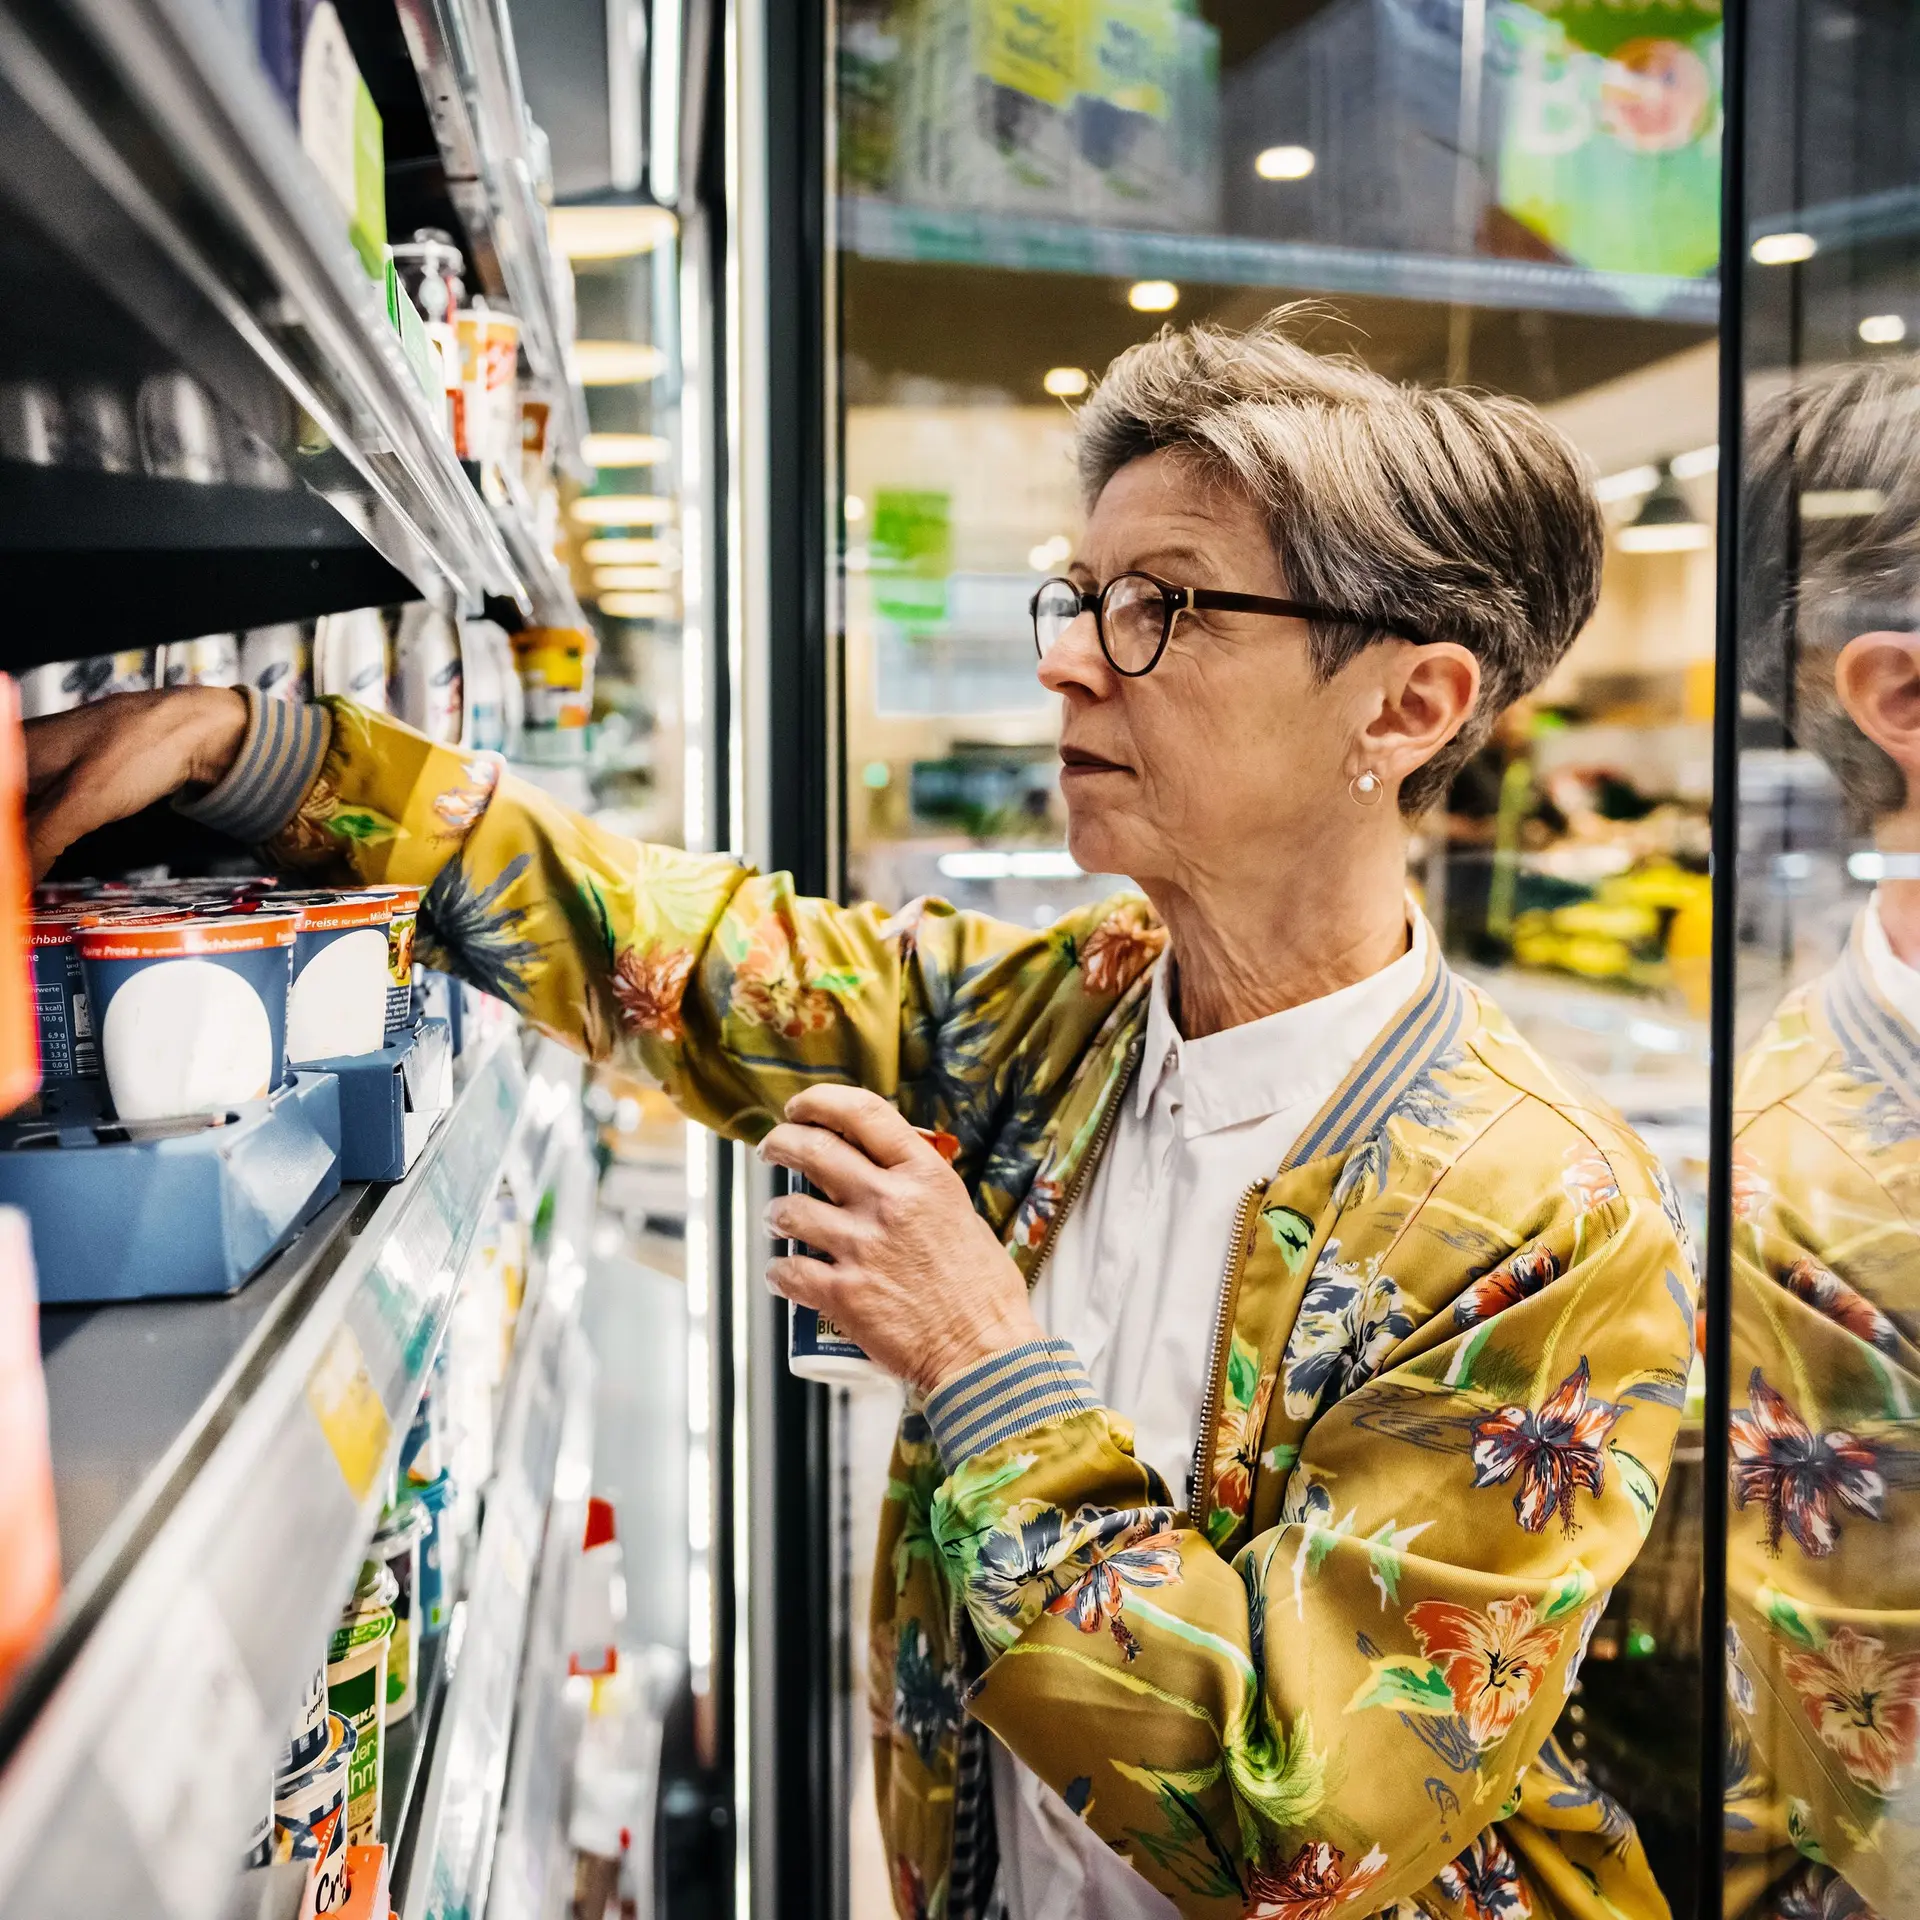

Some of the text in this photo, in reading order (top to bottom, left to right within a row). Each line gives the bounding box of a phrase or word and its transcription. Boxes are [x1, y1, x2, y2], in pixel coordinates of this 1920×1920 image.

[304, 917, 339, 929] Preise
[45, 1004, 63, 1013] kcal)
[47, 1032, 59, 1040] 6,9
[49, 1042, 60, 1050] 3,3
[50, 1051, 61, 1059] 3,3
[348, 1704, 377, 1726] EKA
